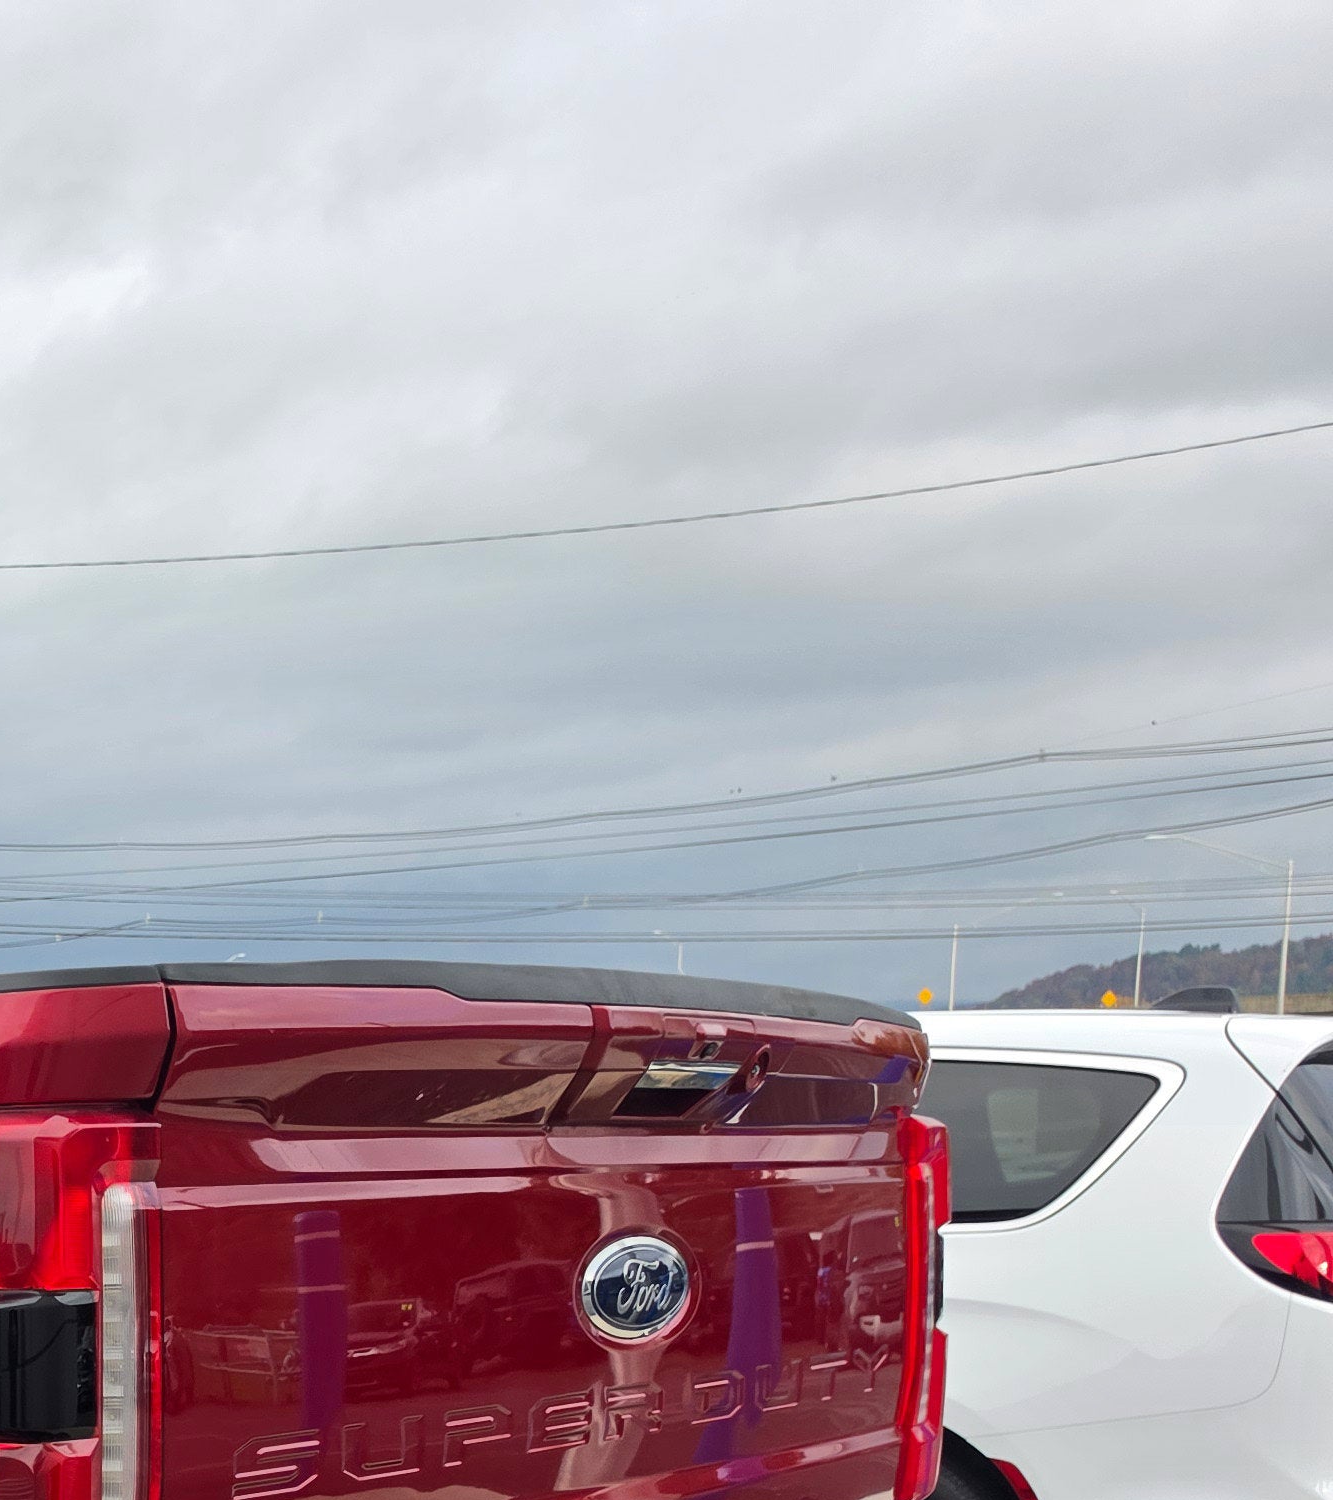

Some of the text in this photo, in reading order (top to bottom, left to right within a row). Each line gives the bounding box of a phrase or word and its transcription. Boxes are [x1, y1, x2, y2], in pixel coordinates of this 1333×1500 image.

[616, 1258, 674, 1316] Ford
[231, 1344, 890, 1500] SUPER DUTY
